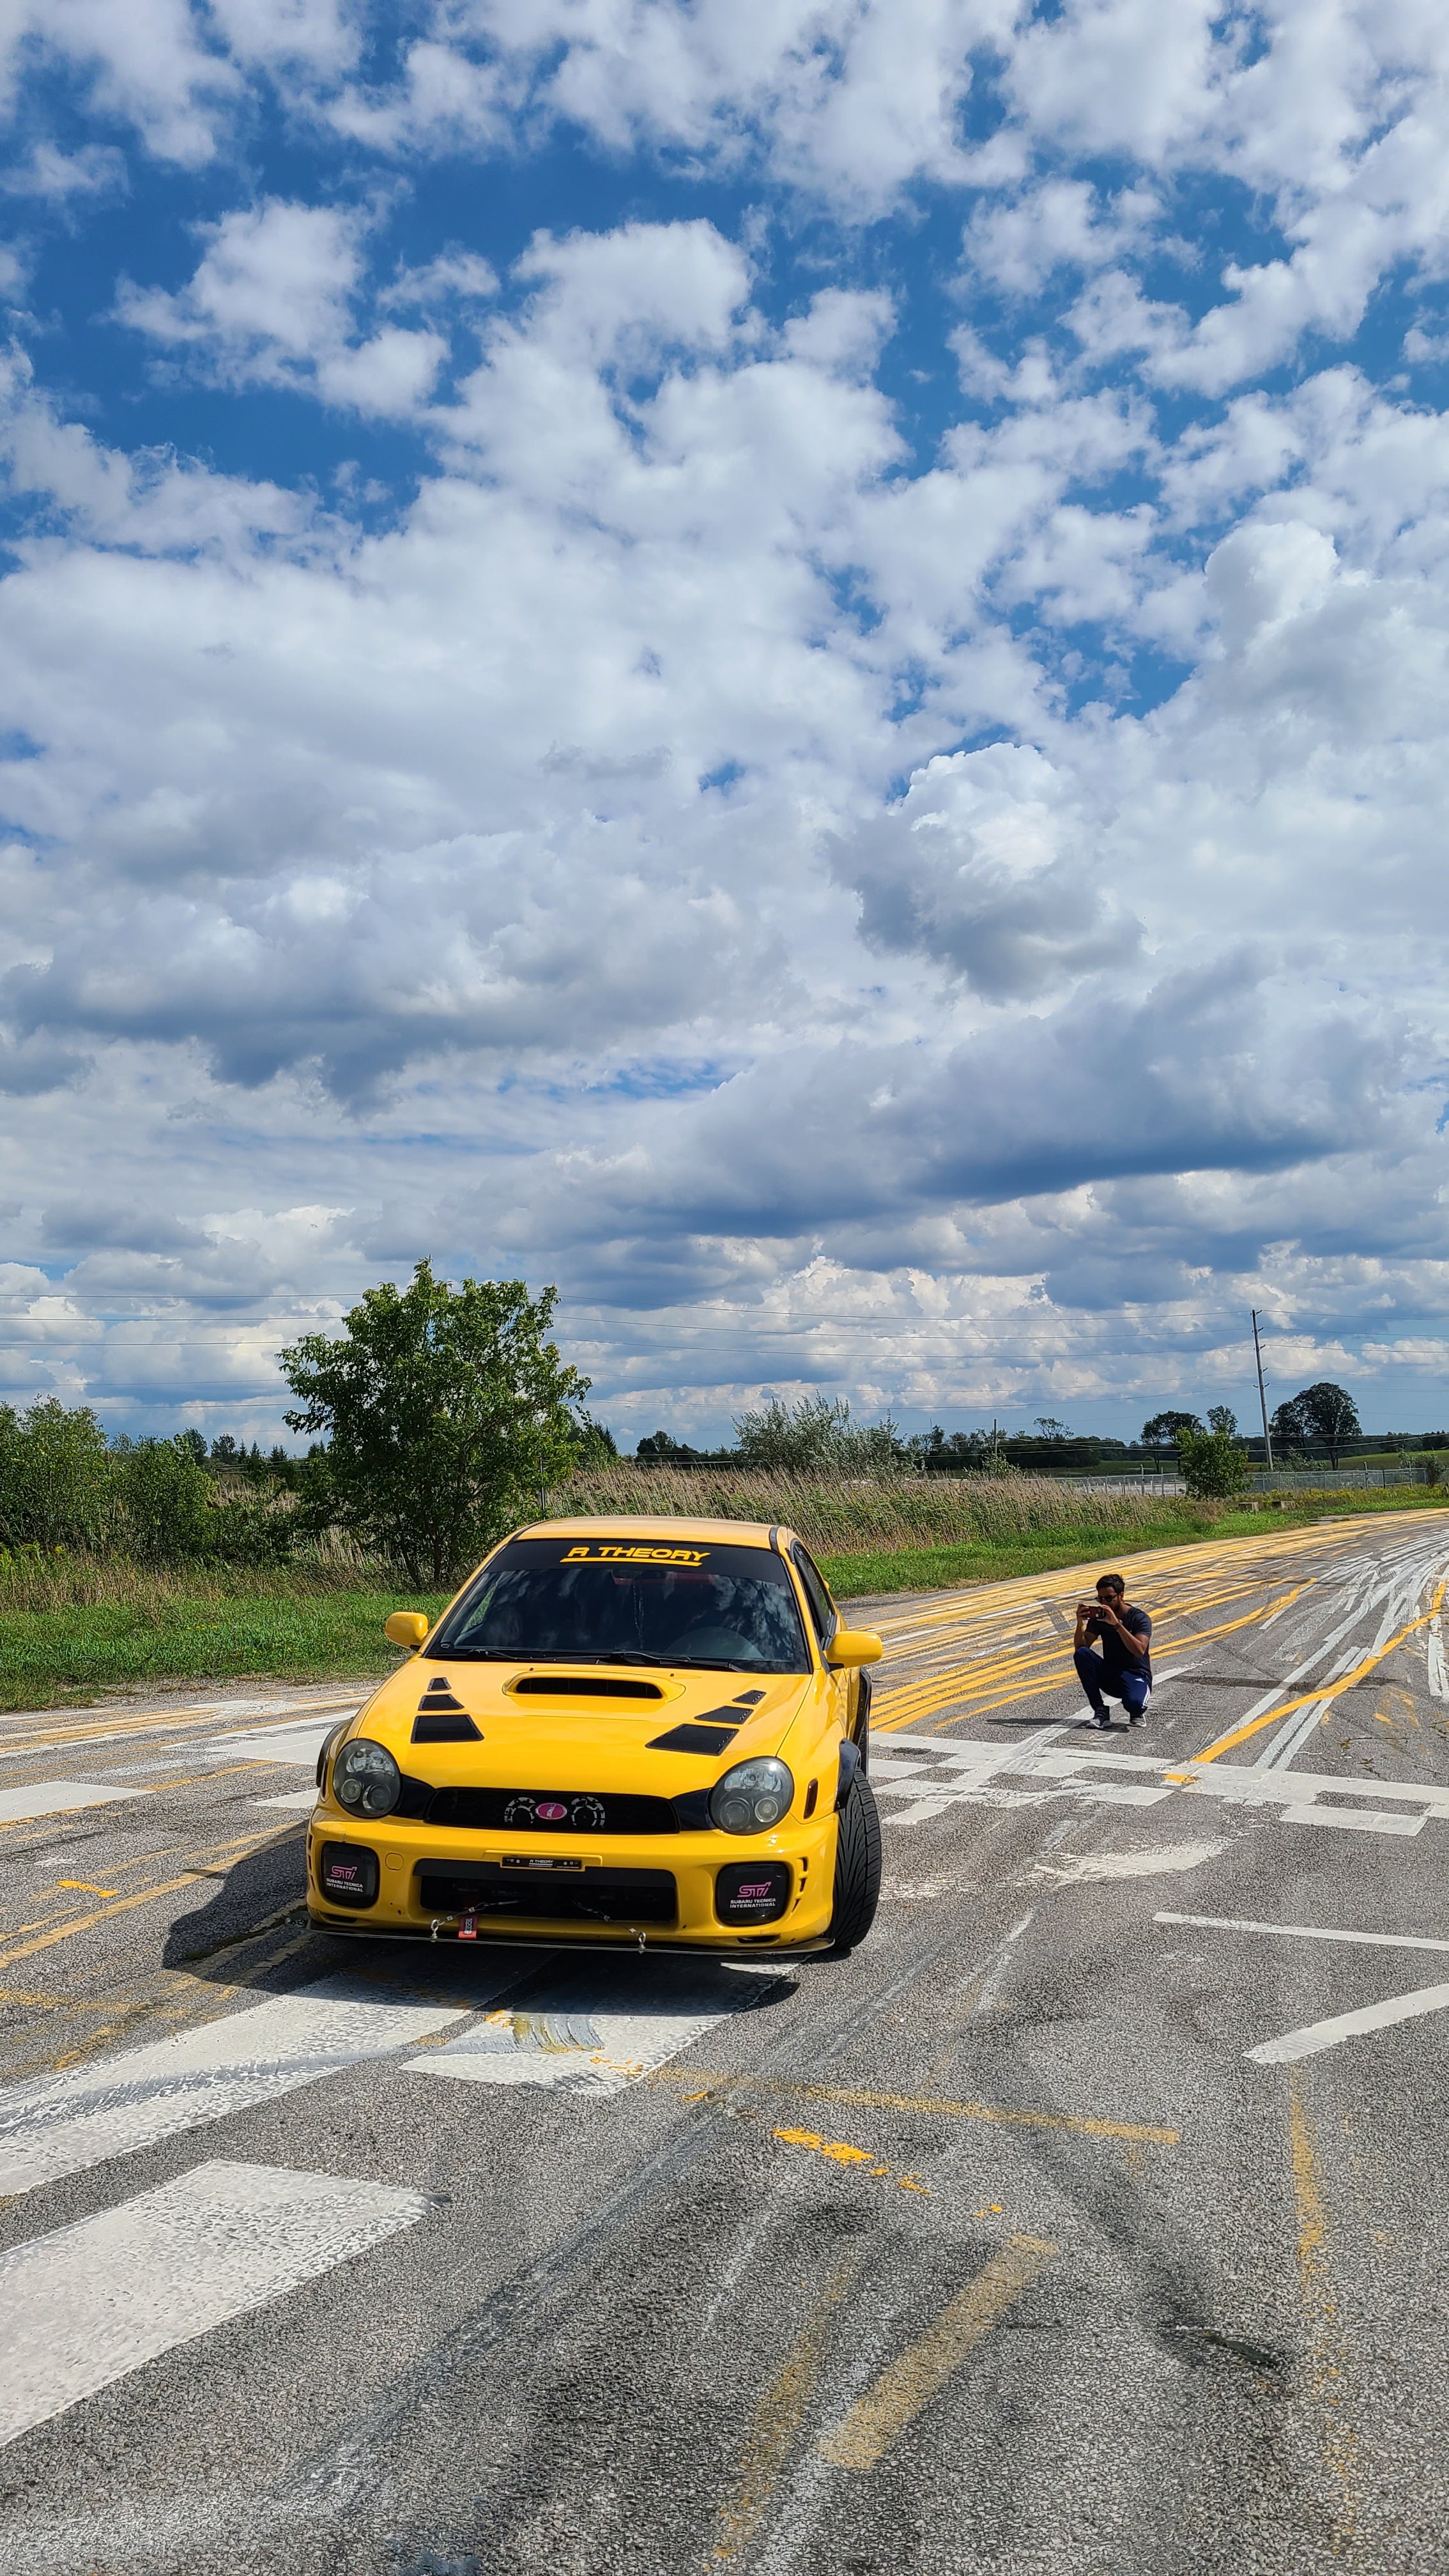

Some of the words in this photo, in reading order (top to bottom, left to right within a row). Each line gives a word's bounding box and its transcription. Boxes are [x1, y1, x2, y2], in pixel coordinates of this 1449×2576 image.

[567, 1547, 590, 1557] R
[598, 1546, 711, 1561] THEORY
[326, 1882, 364, 1892] INTERNATIONAL
